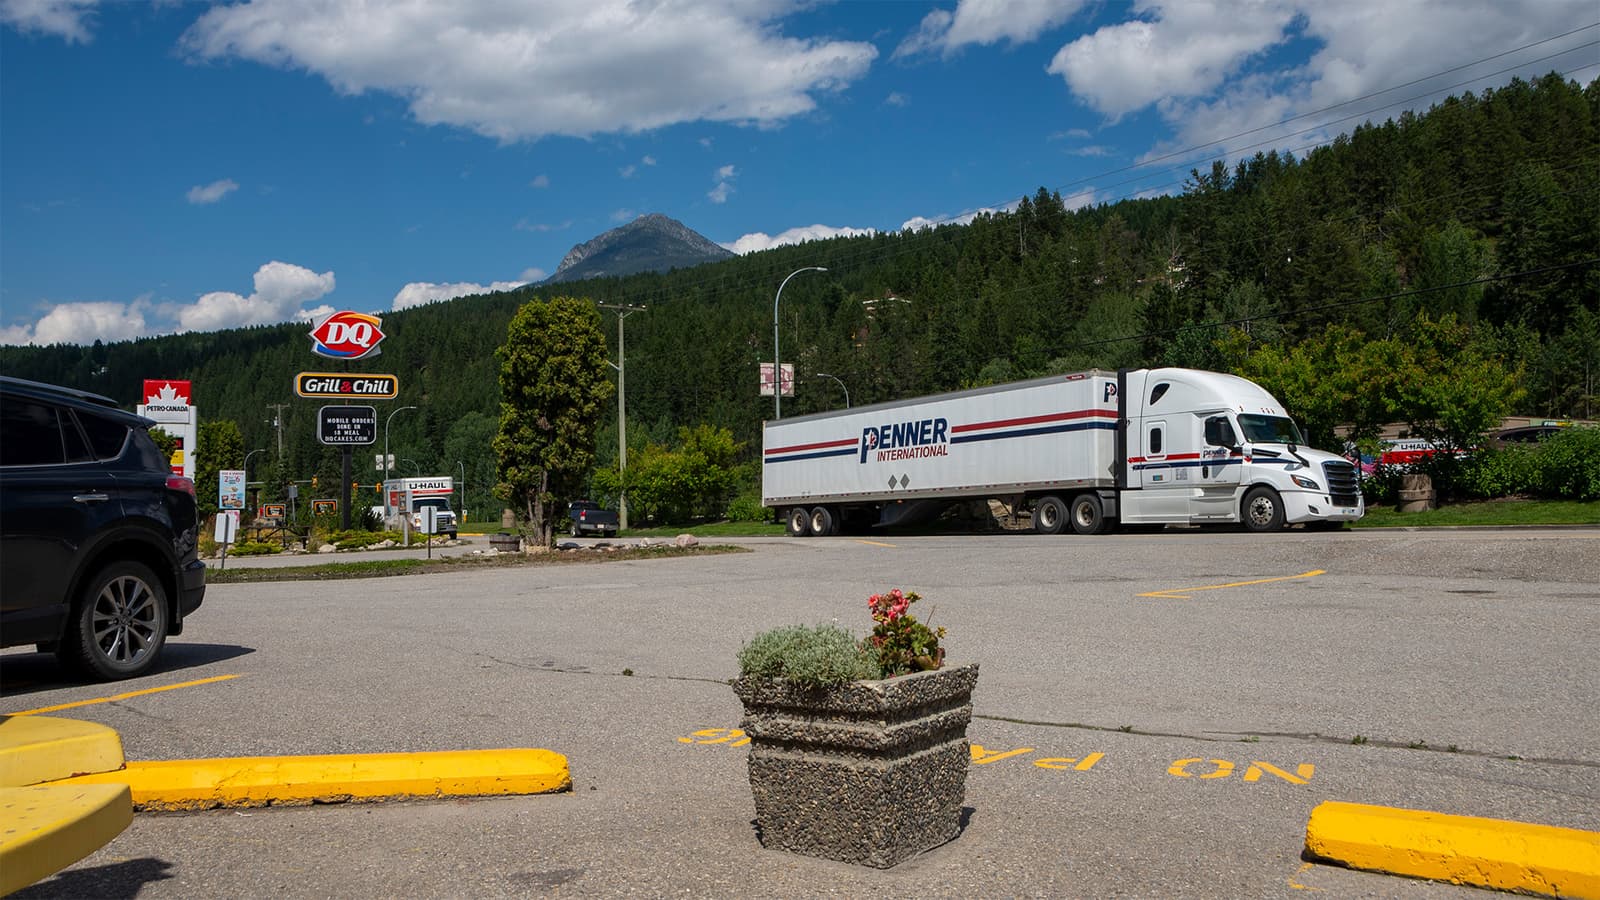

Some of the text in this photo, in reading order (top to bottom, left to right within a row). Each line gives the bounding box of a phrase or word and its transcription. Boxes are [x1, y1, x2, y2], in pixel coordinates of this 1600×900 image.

[325, 322, 373, 348] DQ
[860, 417, 948, 464] PENNER
[877, 444, 948, 462] INTERNATIONAL
